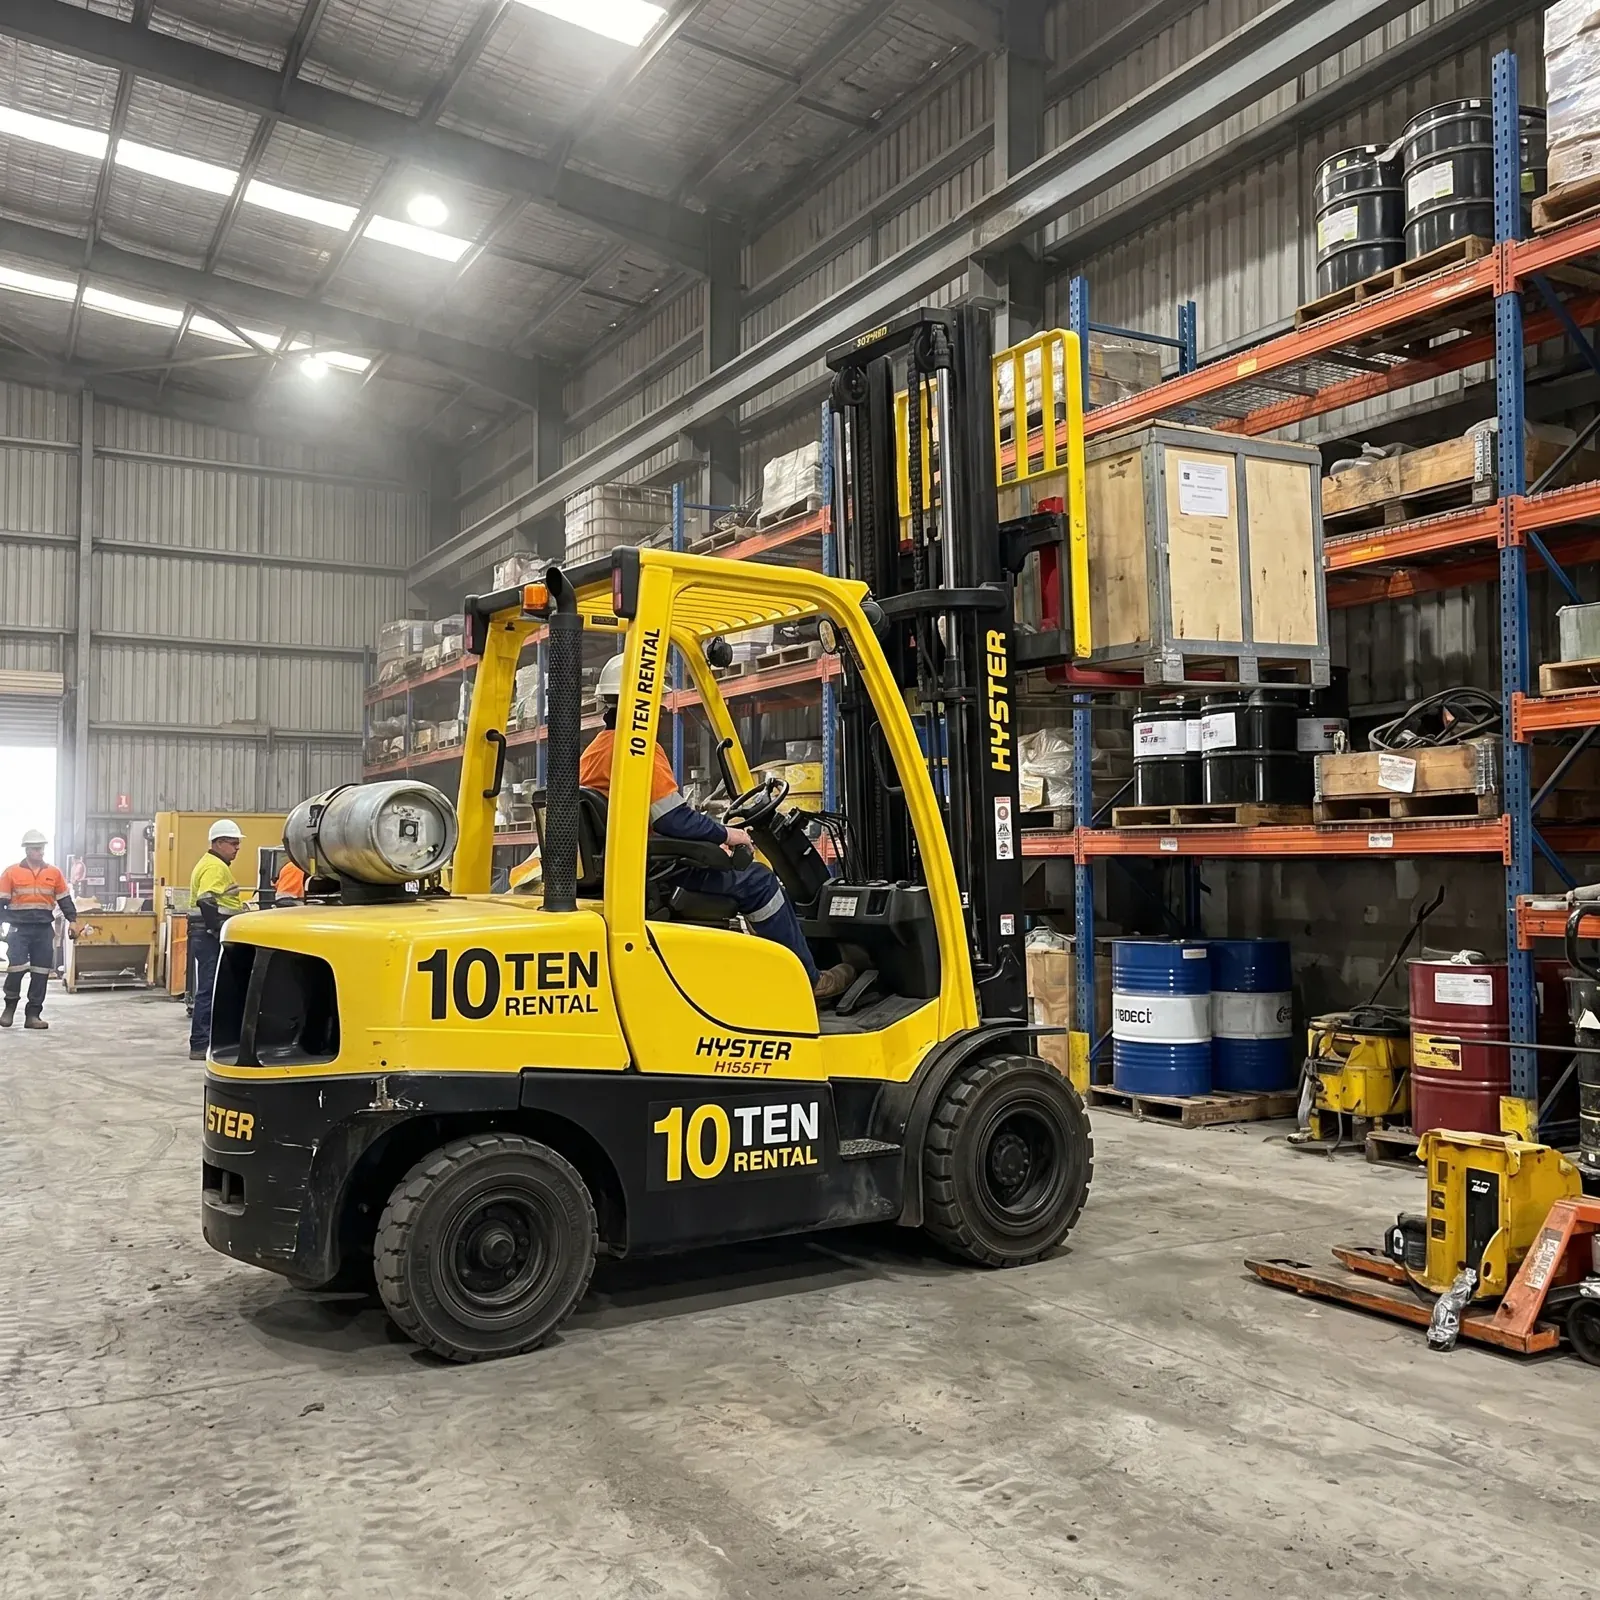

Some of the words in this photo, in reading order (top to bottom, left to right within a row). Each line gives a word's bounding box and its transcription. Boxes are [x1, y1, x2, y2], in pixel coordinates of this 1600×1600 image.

[637, 628, 660, 694] RENTAL
[632, 698, 651, 731] TEN
[986, 629, 1011, 772] HYSTER
[629, 737, 647, 757] 10
[417, 948, 500, 1020] 10
[504, 951, 598, 991] TEN
[505, 994, 599, 1016] RENTAL
[695, 1037, 792, 1061] HYSTER
[713, 1061, 772, 1075] H155FT
[207, 1103, 255, 1141] STER
[654, 1103, 731, 1181] 10
[734, 1101, 819, 1147] TEN
[734, 1145, 818, 1173] RENTAL
